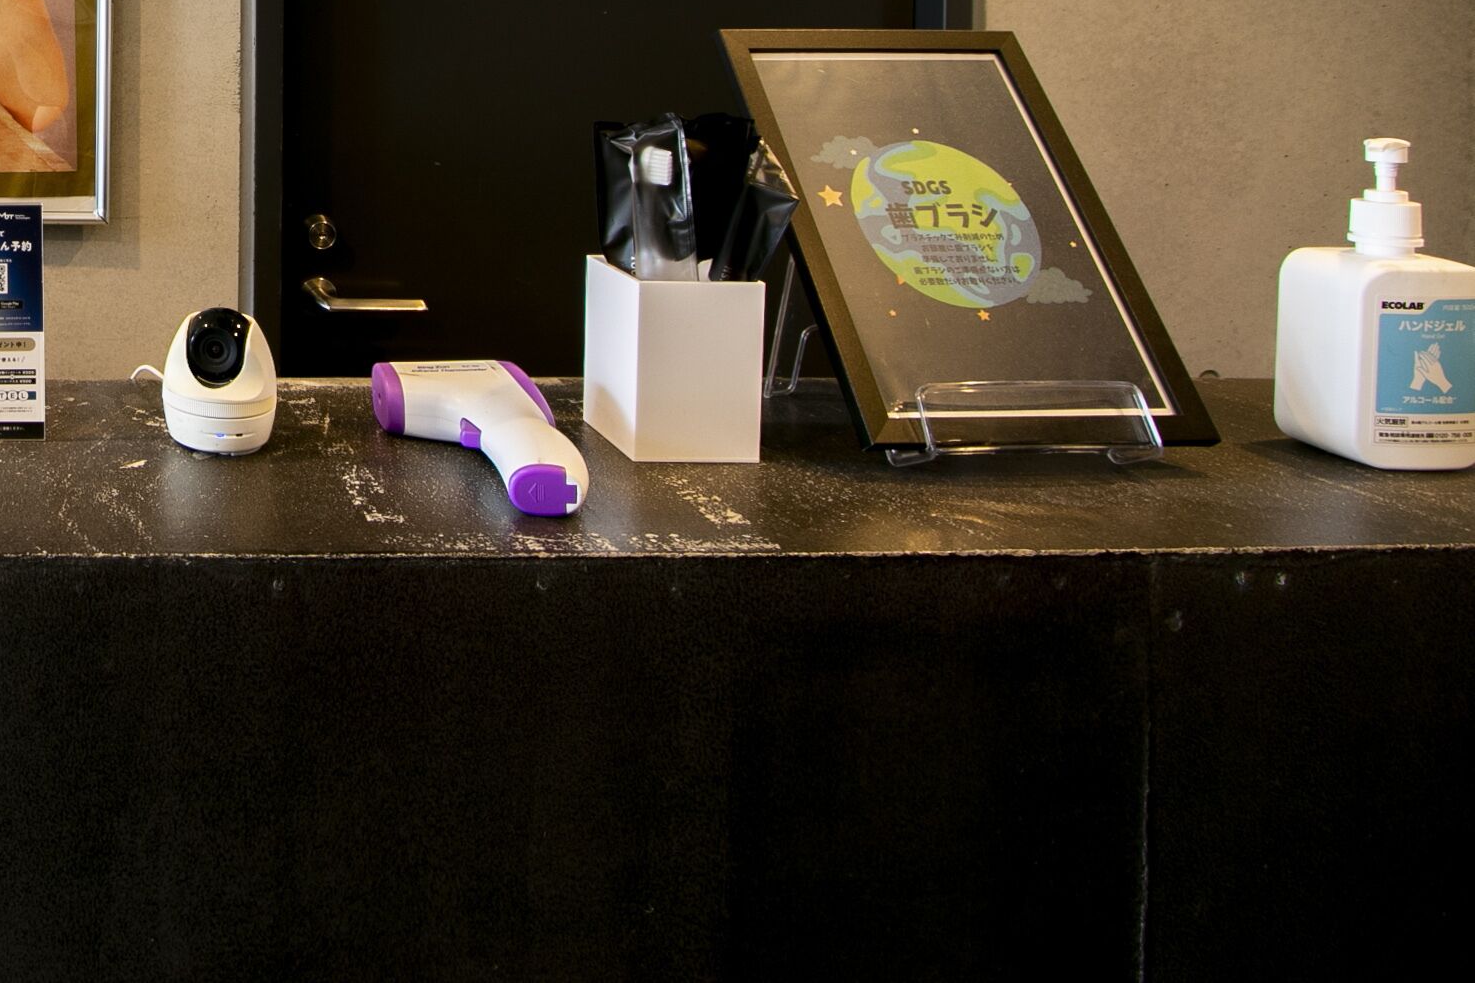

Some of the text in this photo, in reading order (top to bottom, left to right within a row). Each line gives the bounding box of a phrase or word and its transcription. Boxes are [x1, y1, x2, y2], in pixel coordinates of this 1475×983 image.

[901, 180, 952, 195] SDGS
[885, 202, 998, 229] 歯ブラシ
[1381, 301, 1425, 310] ECOLAB
[1398, 320, 1466, 332] ハンドジェル
